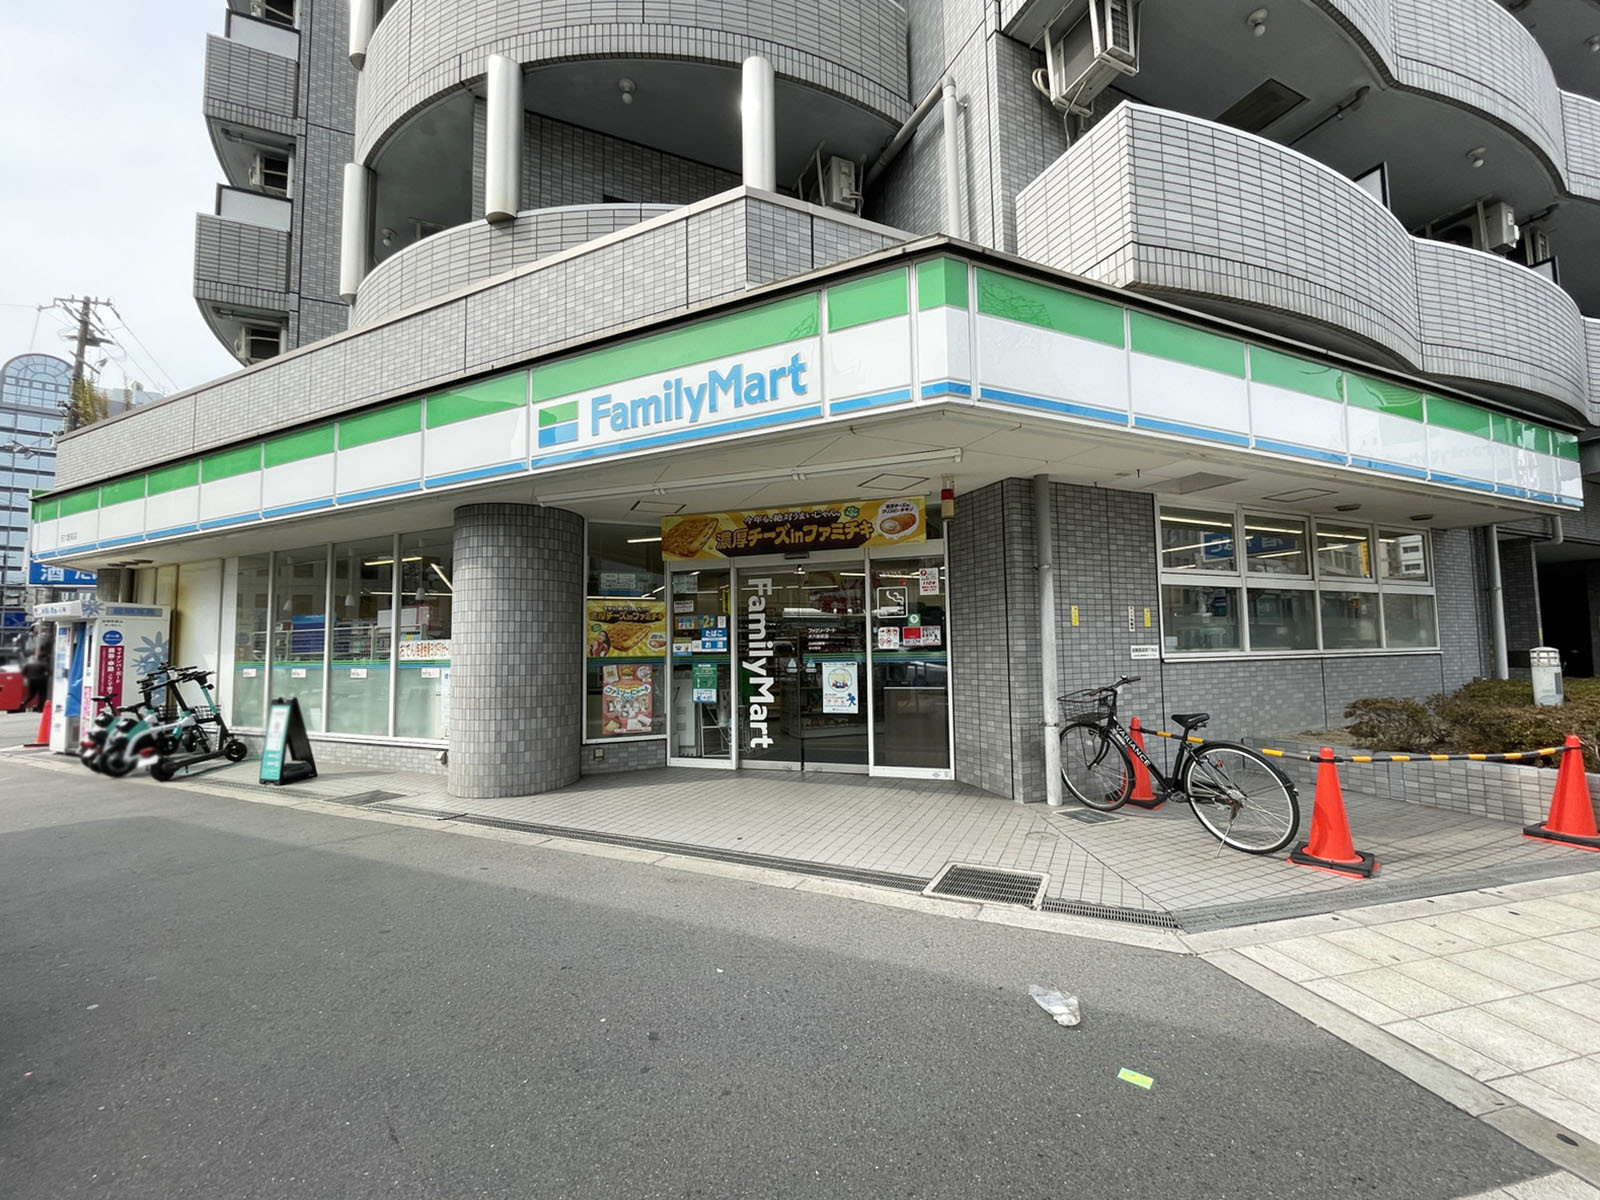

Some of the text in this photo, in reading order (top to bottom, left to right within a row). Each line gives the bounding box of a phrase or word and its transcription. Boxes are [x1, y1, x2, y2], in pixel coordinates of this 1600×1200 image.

[591, 353, 807, 436] FamilyMart
[716, 520, 874, 548] 濃厚チーズinファミチキ
[705, 629, 723, 637] たばこ
[742, 577, 776, 749] FamilyMart
[1115, 724, 1152, 766] VARIANCE
